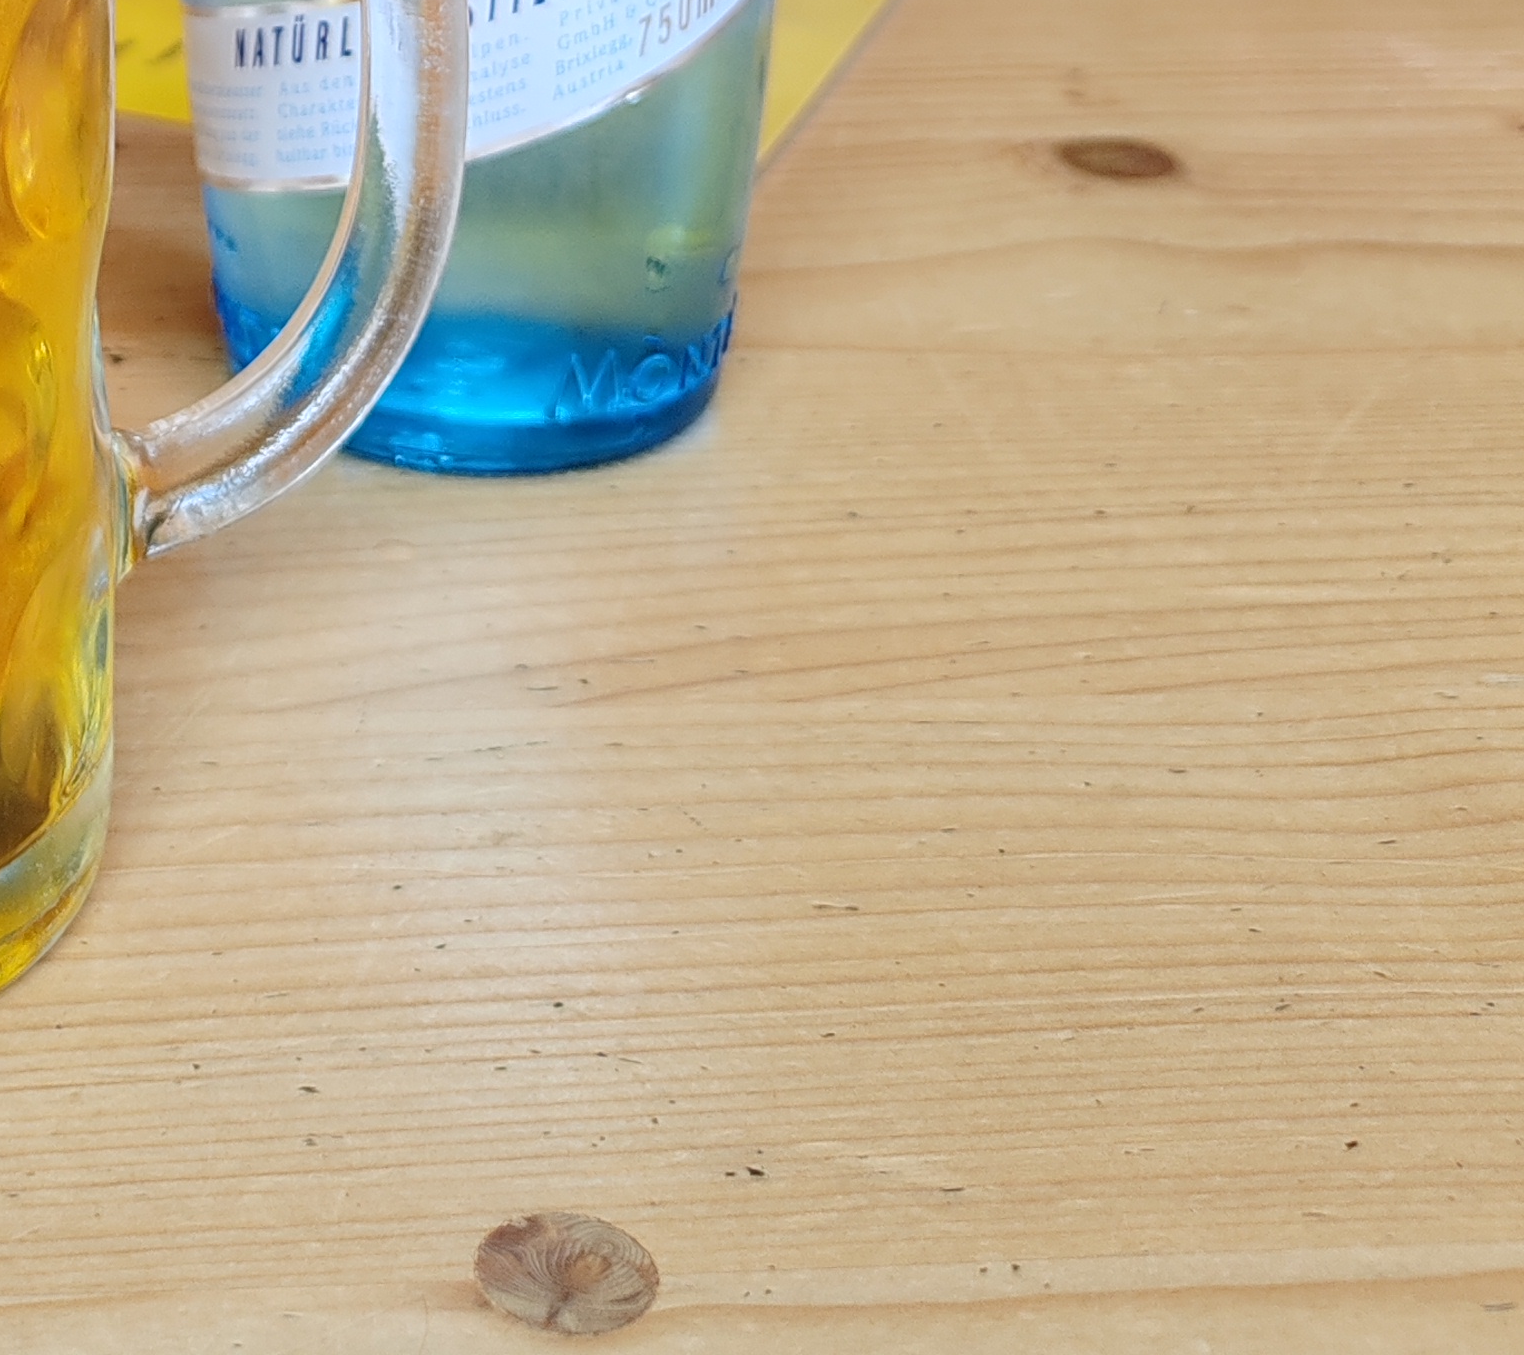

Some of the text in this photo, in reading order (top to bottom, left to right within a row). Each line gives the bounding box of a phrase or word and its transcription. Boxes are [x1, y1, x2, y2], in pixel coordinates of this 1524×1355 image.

[233, 13, 355, 69] NATÜRL
[472, 32, 530, 60] lpen.
[557, 13, 616, 50] GmbH
[277, 97, 356, 119] Charakte
[470, 51, 531, 82] nalyse
[552, 59, 625, 101] Austria
